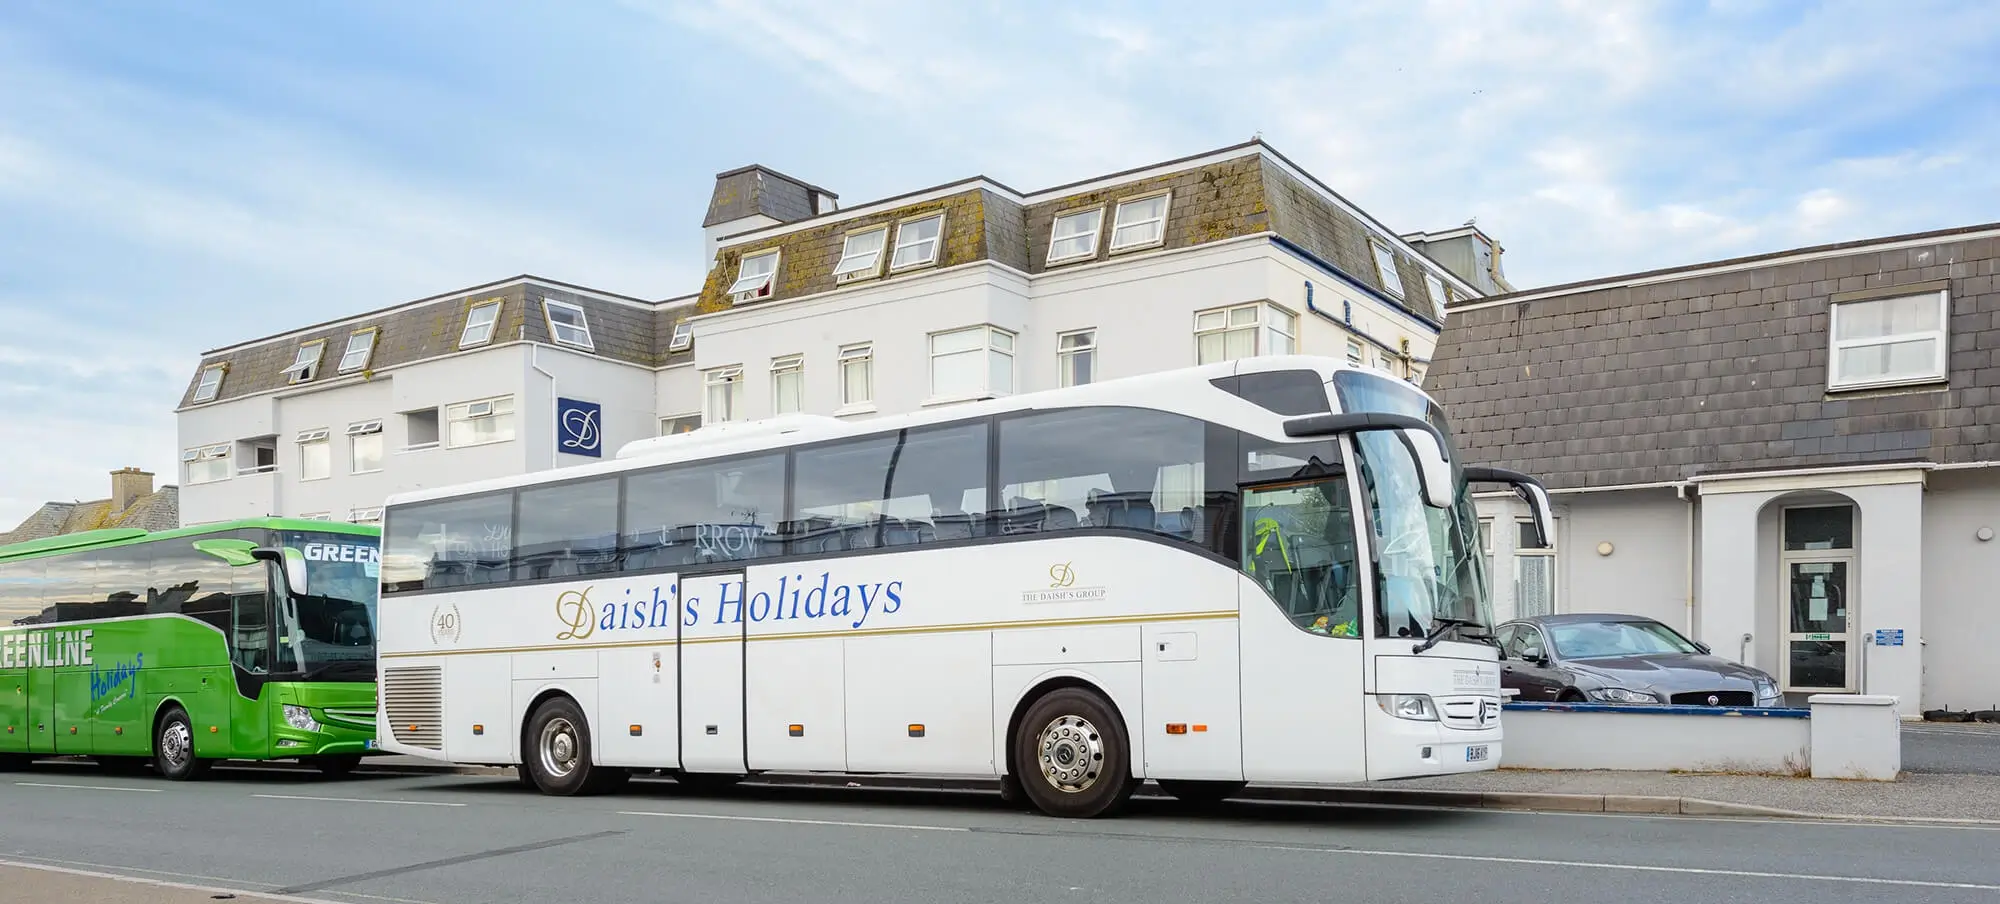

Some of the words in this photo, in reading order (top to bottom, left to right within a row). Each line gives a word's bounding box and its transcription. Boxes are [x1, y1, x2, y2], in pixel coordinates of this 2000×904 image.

[304, 543, 380, 563] GREEN
[556, 583, 700, 641] Daish's
[713, 571, 903, 629] Holidays
[1023, 592, 1038, 602] THE
[1040, 591, 1074, 601] DAISH'S
[1076, 589, 1106, 599] GROUP
[437, 613, 455, 629] 40
[0, 629, 93, 669] EENLINE
[90, 652, 144, 702] Holidays
